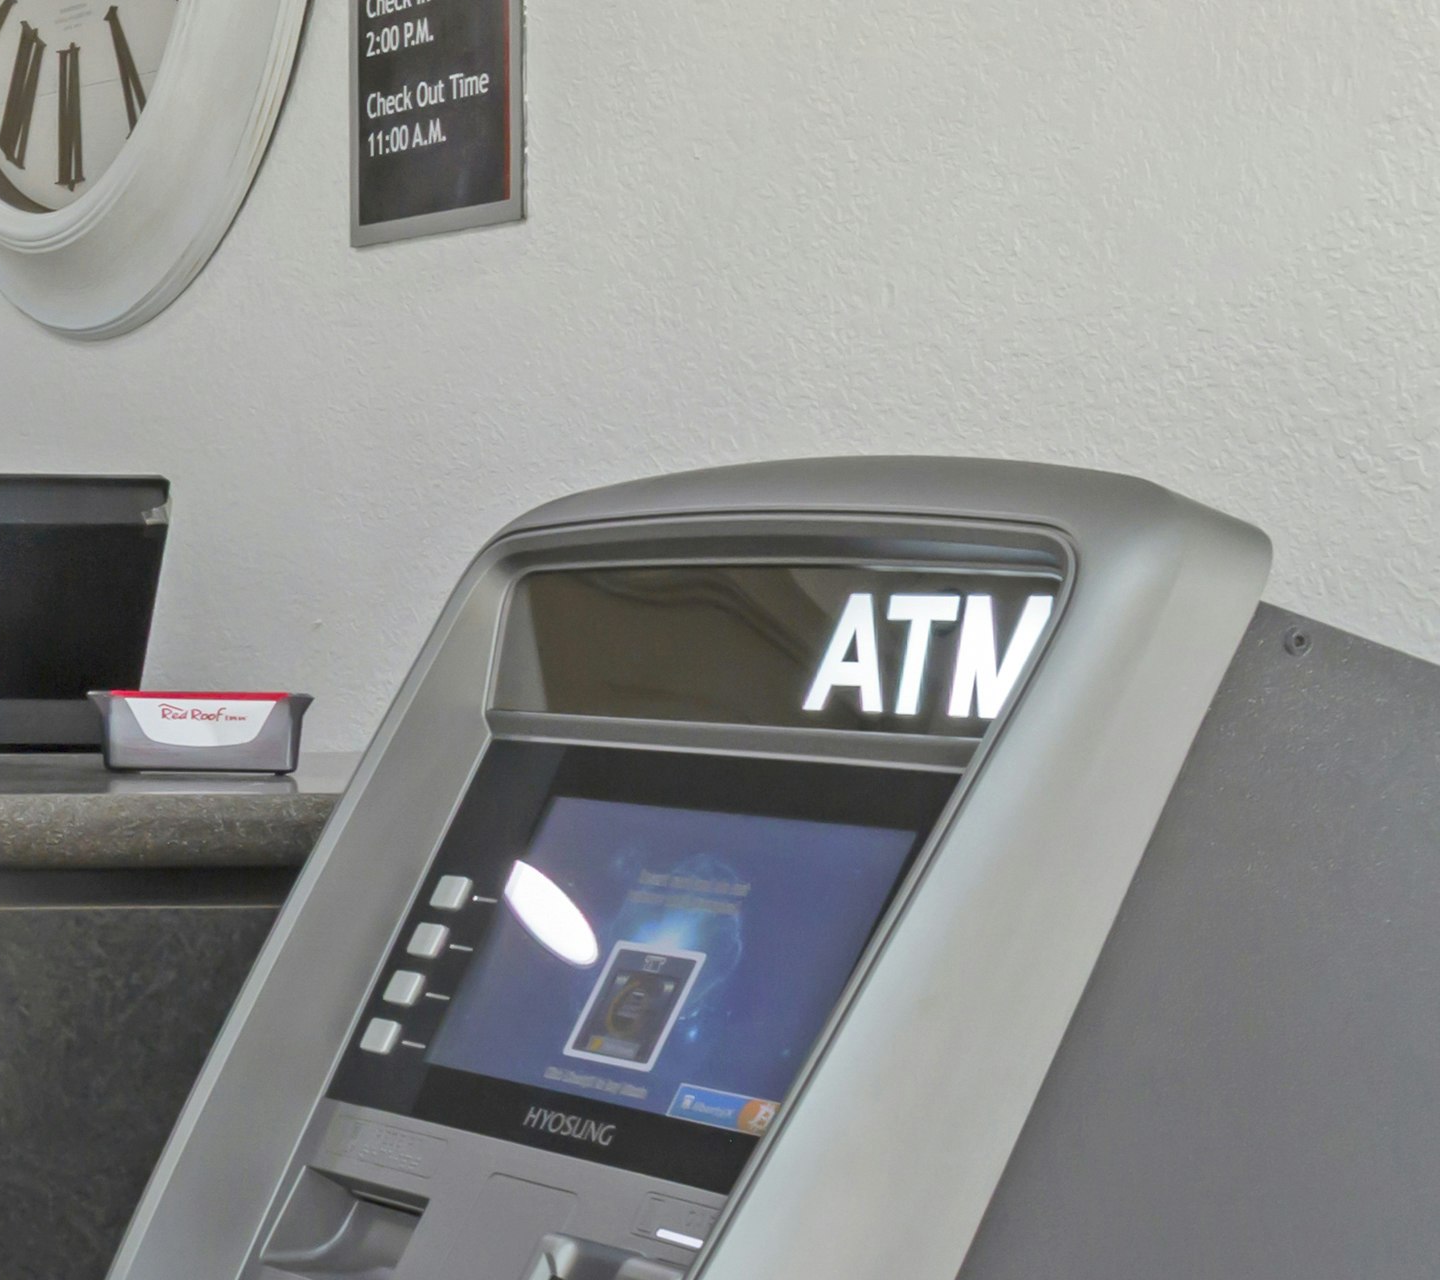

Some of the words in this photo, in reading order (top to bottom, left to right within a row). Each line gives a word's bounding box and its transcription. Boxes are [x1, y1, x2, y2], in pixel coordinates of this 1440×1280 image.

[365, 24, 401, 58] 2:00
[403, 16, 435, 48] P.M.
[366, 84, 413, 120] Check
[416, 77, 446, 108] Out
[448, 70, 490, 103] Time
[367, 124, 410, 158] 11:00
[412, 116, 447, 148] A.M.
[801, 592, 1054, 719] ATM
[161, 706, 189, 721] Red
[191, 707, 228, 722] Roof
[525, 1106, 617, 1147] HYOSUNG
